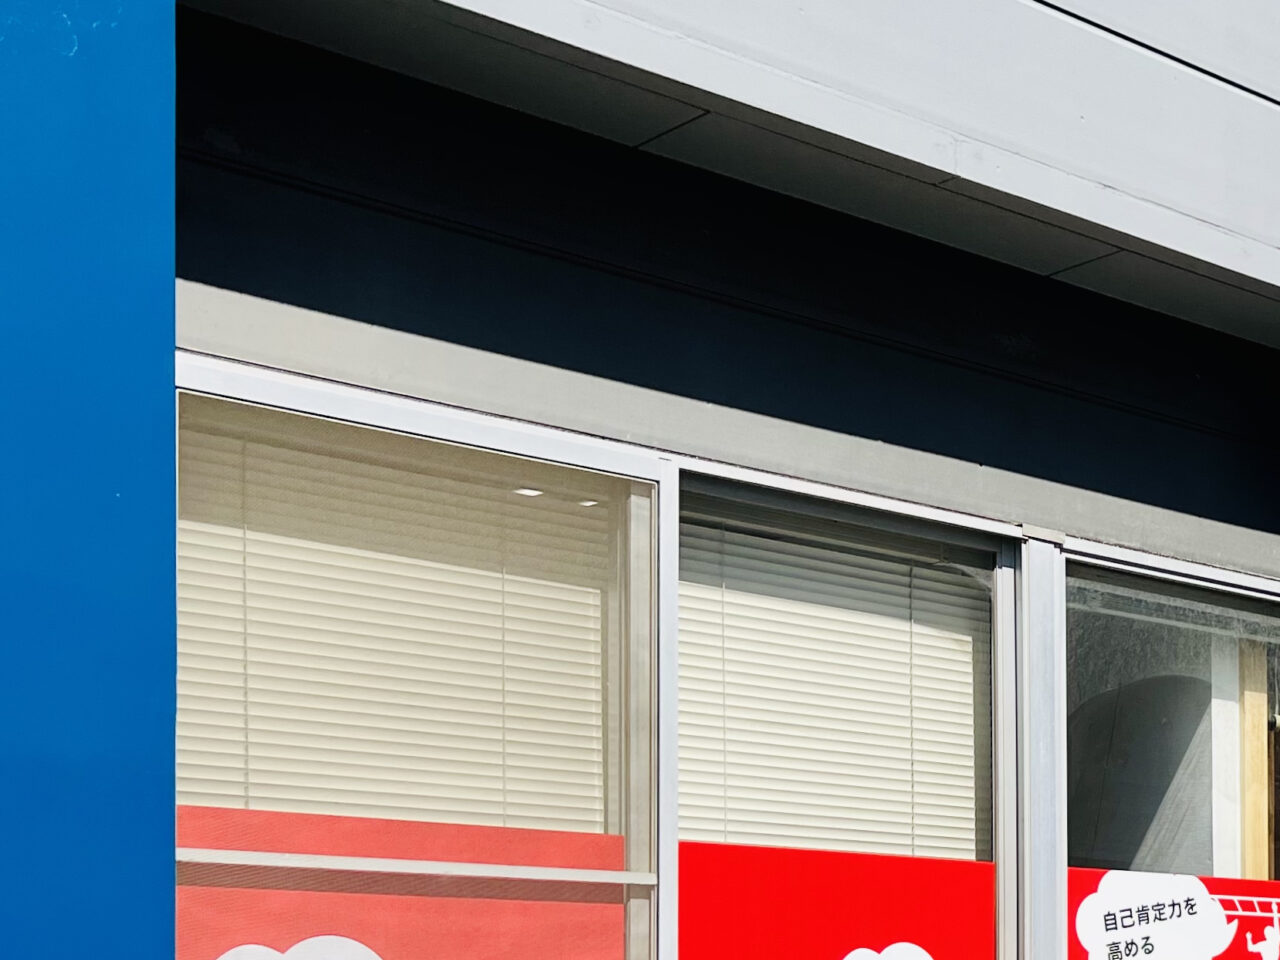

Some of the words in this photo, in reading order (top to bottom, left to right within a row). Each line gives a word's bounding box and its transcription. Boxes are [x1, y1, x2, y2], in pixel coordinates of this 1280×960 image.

[1103, 896, 1198, 932] 自己肯定力を
